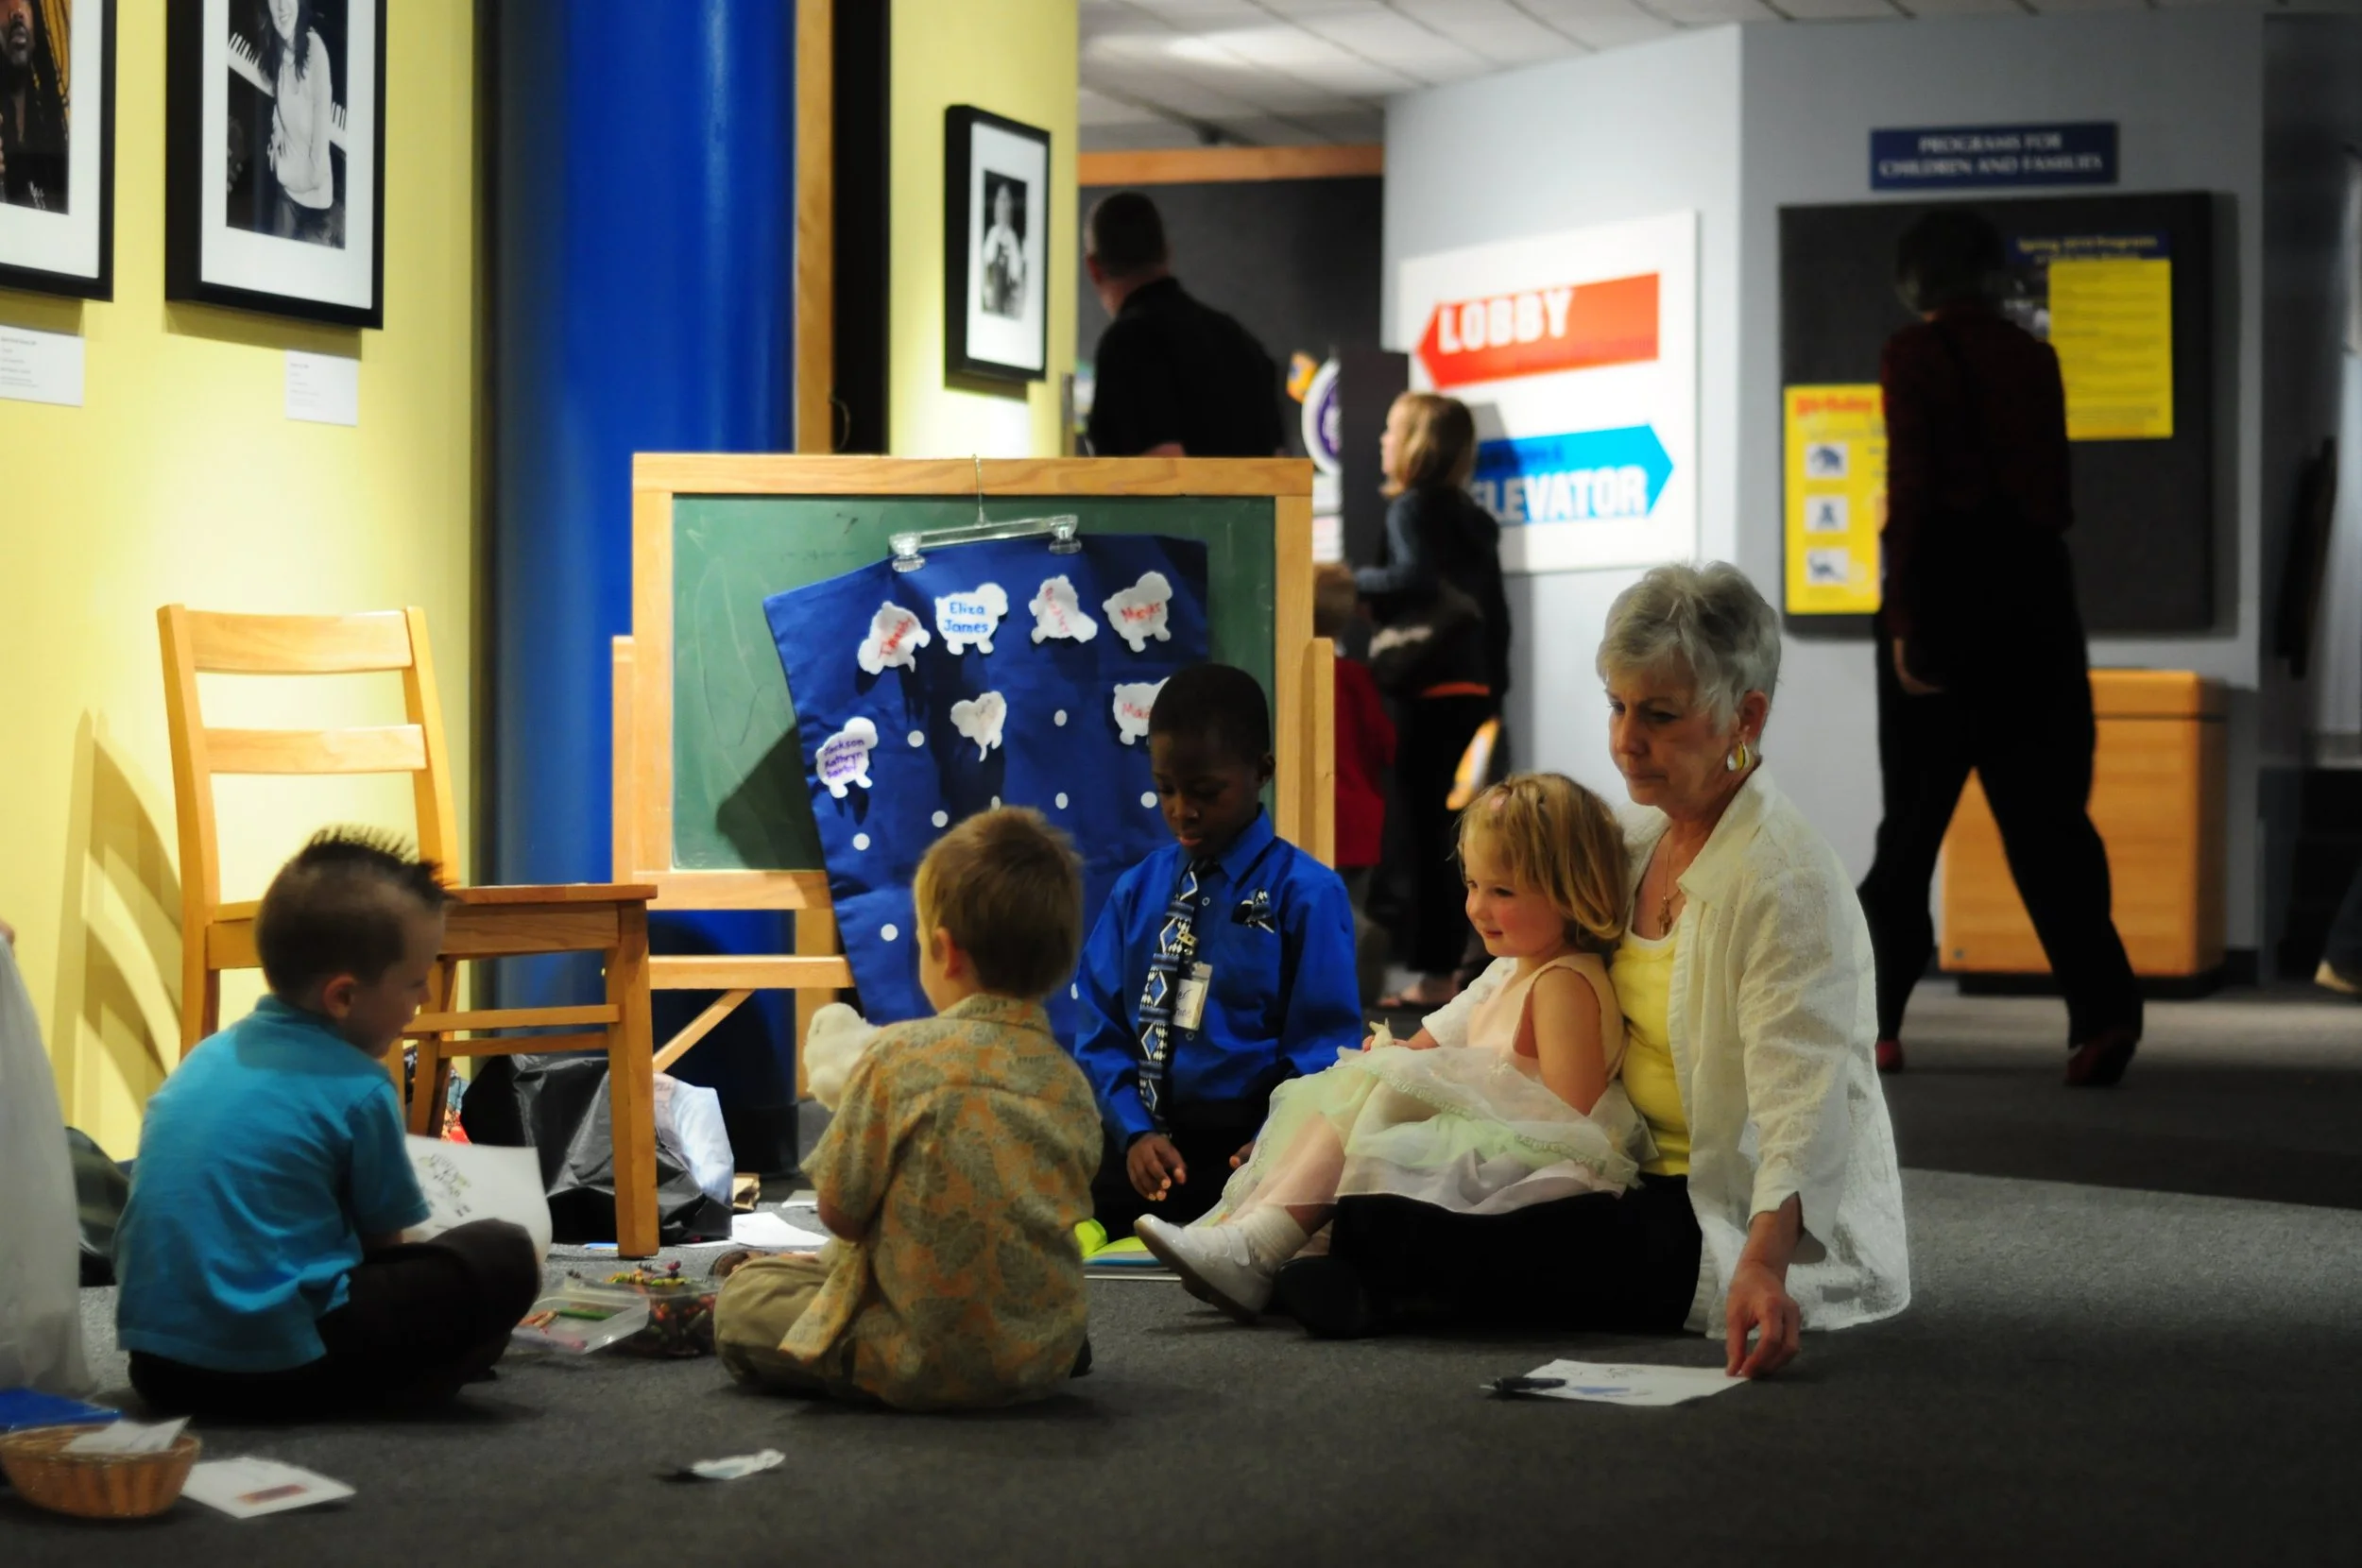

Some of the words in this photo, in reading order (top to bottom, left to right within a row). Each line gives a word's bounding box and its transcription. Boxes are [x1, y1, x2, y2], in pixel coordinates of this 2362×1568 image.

[1917, 134, 2020, 154] PROGRAMS
[2024, 131, 2062, 151] FOR
[1877, 156, 1972, 178] CHILDREN
[1977, 154, 2018, 175] AND
[2022, 151, 2103, 172] FAMILIES
[1438, 287, 1574, 356] LOBBY
[949, 602, 985, 616] Eliza
[944, 619, 989, 634] James
